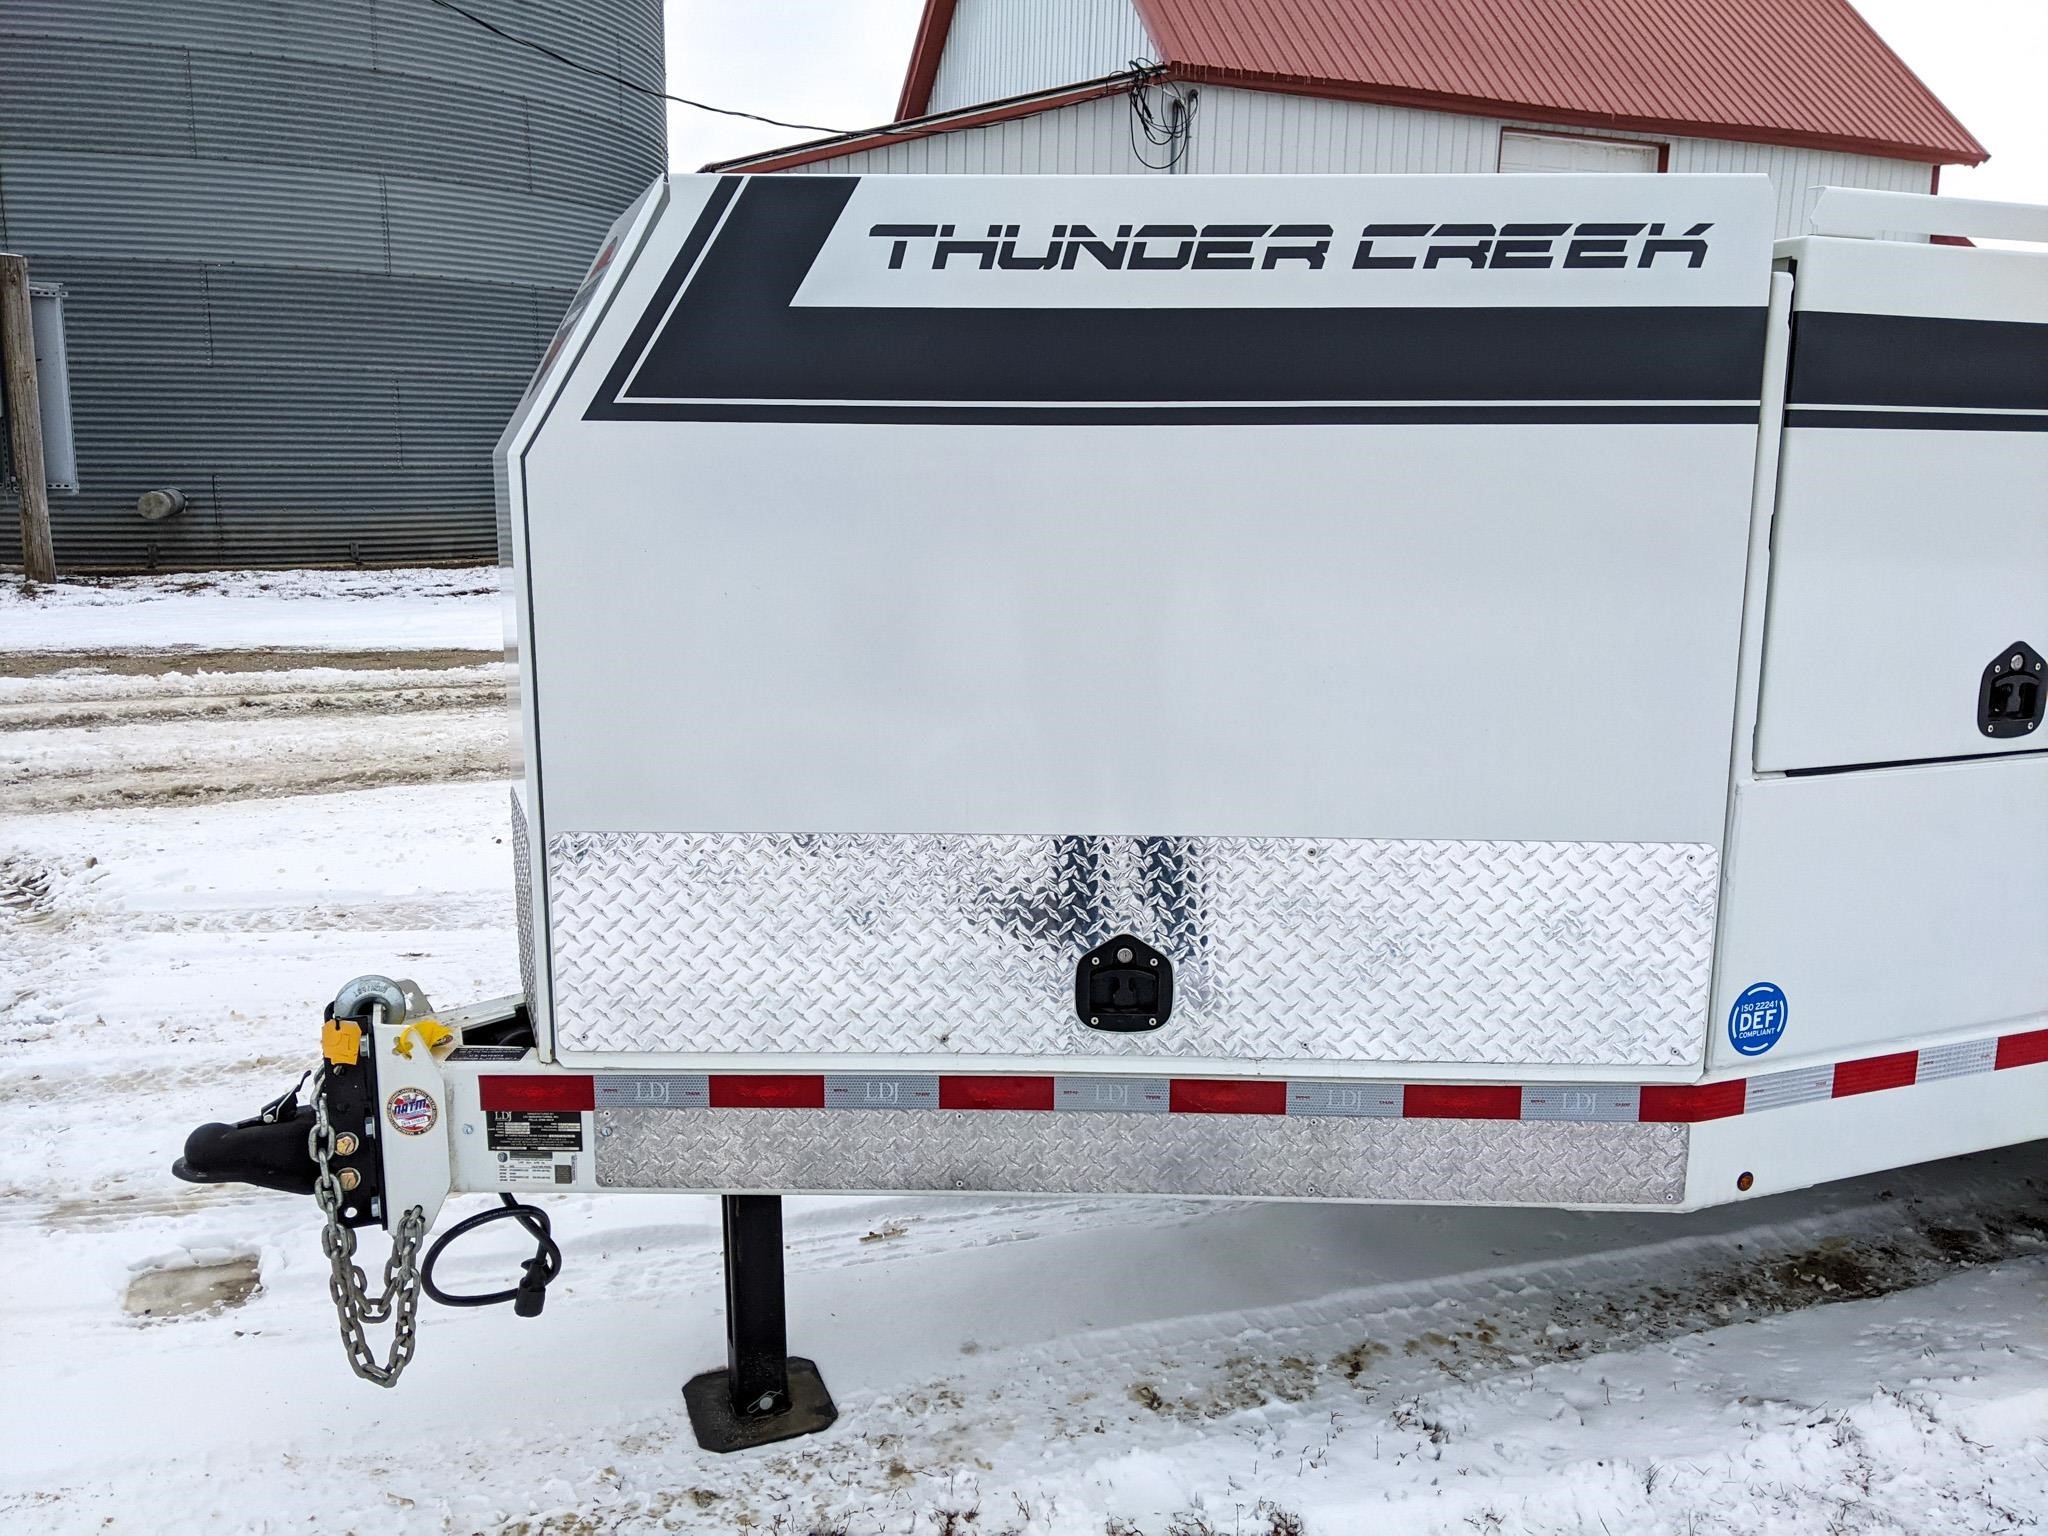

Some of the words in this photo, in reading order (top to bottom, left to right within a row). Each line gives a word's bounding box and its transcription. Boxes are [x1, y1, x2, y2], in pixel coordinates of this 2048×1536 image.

[868, 224, 1334, 270] THUNDER
[1352, 223, 1715, 269] CREEK
[1741, 1004, 1754, 1013] ISO
[1755, 1000, 1778, 1011] 22241
[1739, 1009, 1777, 1031] DEF
[1738, 1027, 1775, 1039] COMPLIANT
[635, 1081, 669, 1104] LDJ
[864, 1082, 899, 1104] LDJ
[1326, 1089, 1362, 1111] LDJ
[1560, 1092, 1596, 1114] LDJ
[494, 1111, 512, 1122] LDJ
